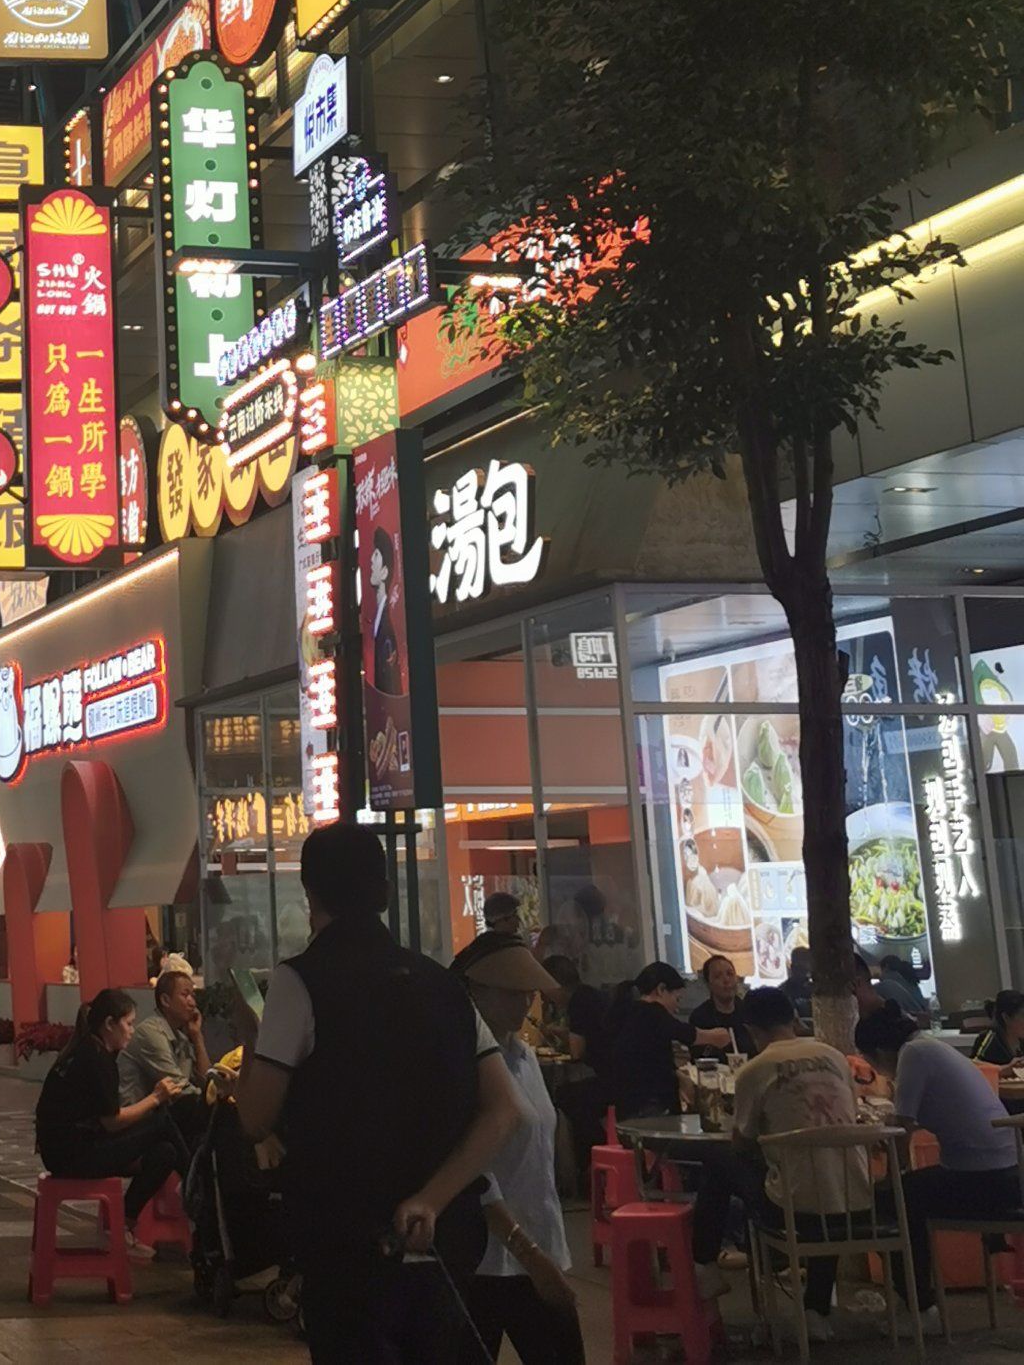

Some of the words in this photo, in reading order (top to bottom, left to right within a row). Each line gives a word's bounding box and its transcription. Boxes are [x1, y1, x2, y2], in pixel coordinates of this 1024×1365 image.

[37, 263, 78, 278] SHU
[80, 265, 107, 316] 火鍋
[76, 348, 107, 499] 一生所學
[228, 384, 283, 443] 云南过桥米线
[430, 459, 543, 603] 湯包
[127, 644, 156, 678] BEAR
